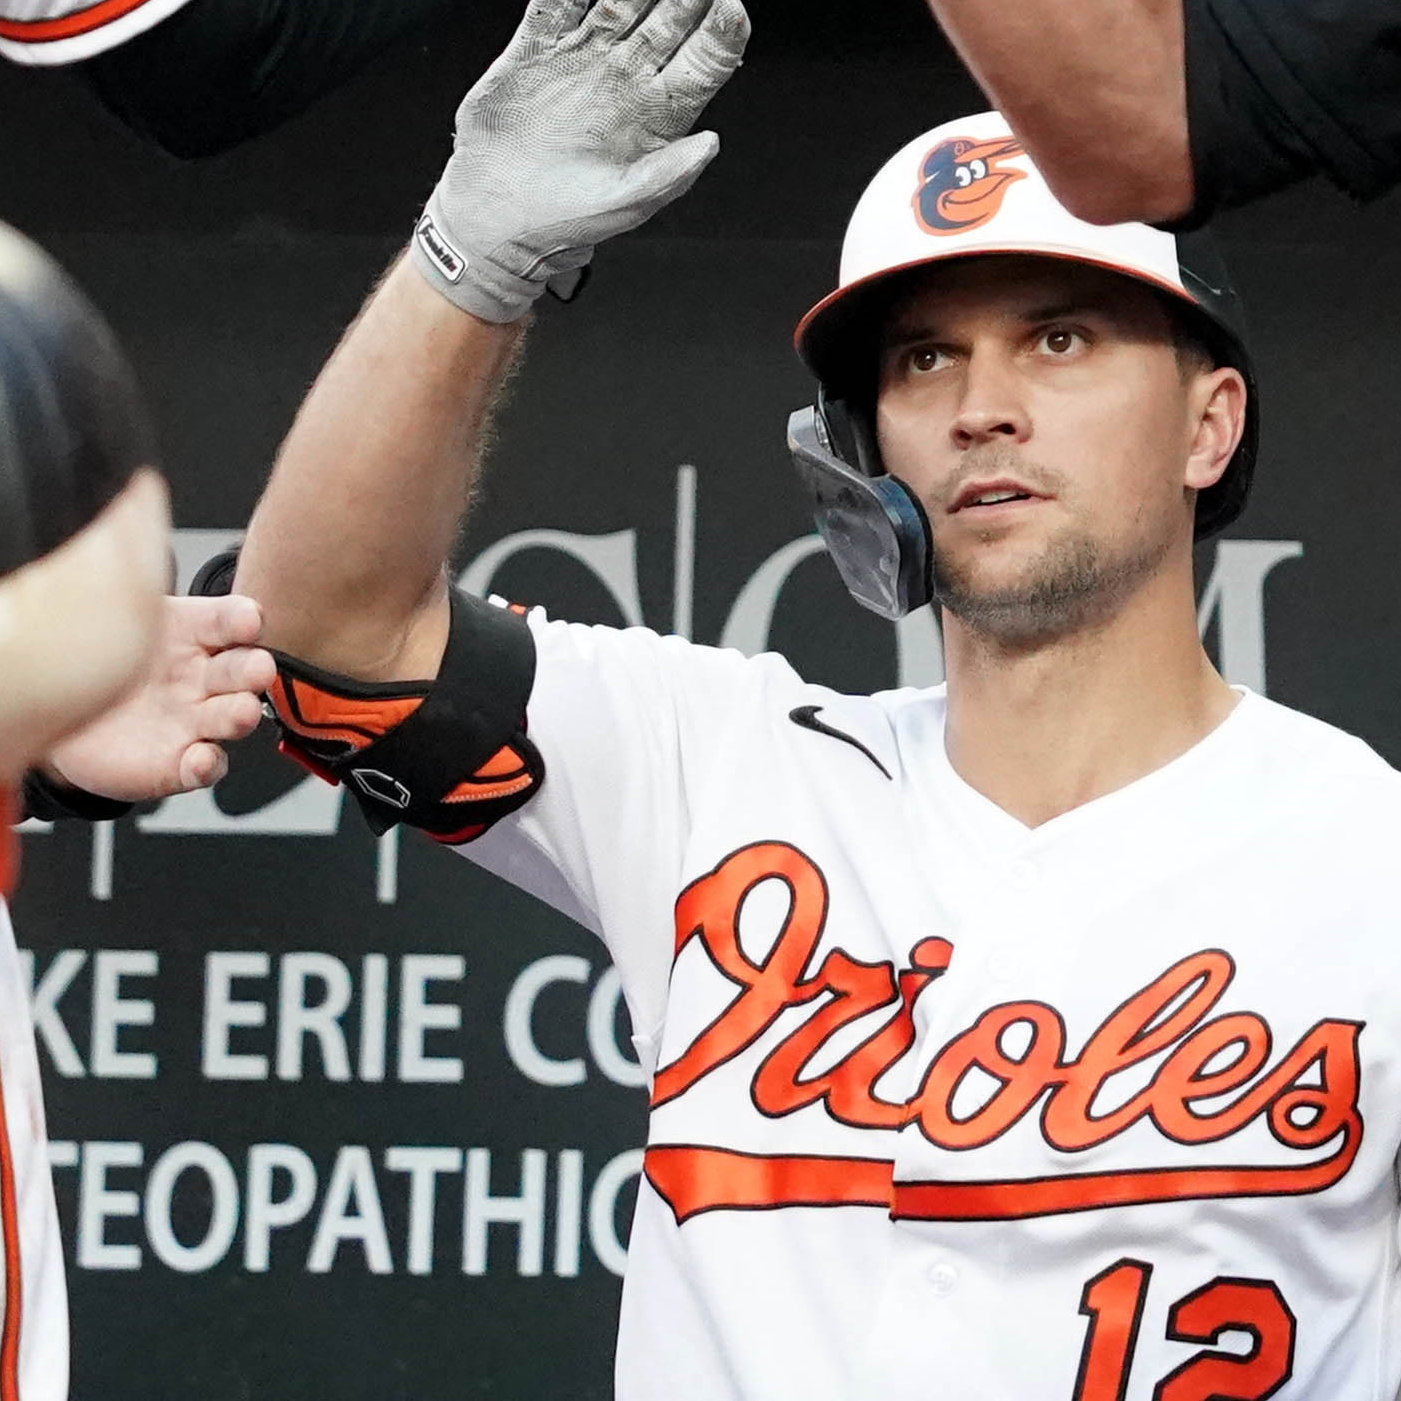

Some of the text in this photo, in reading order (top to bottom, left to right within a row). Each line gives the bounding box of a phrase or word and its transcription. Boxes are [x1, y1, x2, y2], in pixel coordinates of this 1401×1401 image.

[202, 951, 466, 1082] ERIE
[649, 839, 1366, 1196] Orioles
[1072, 1258, 1297, 1401] 12
